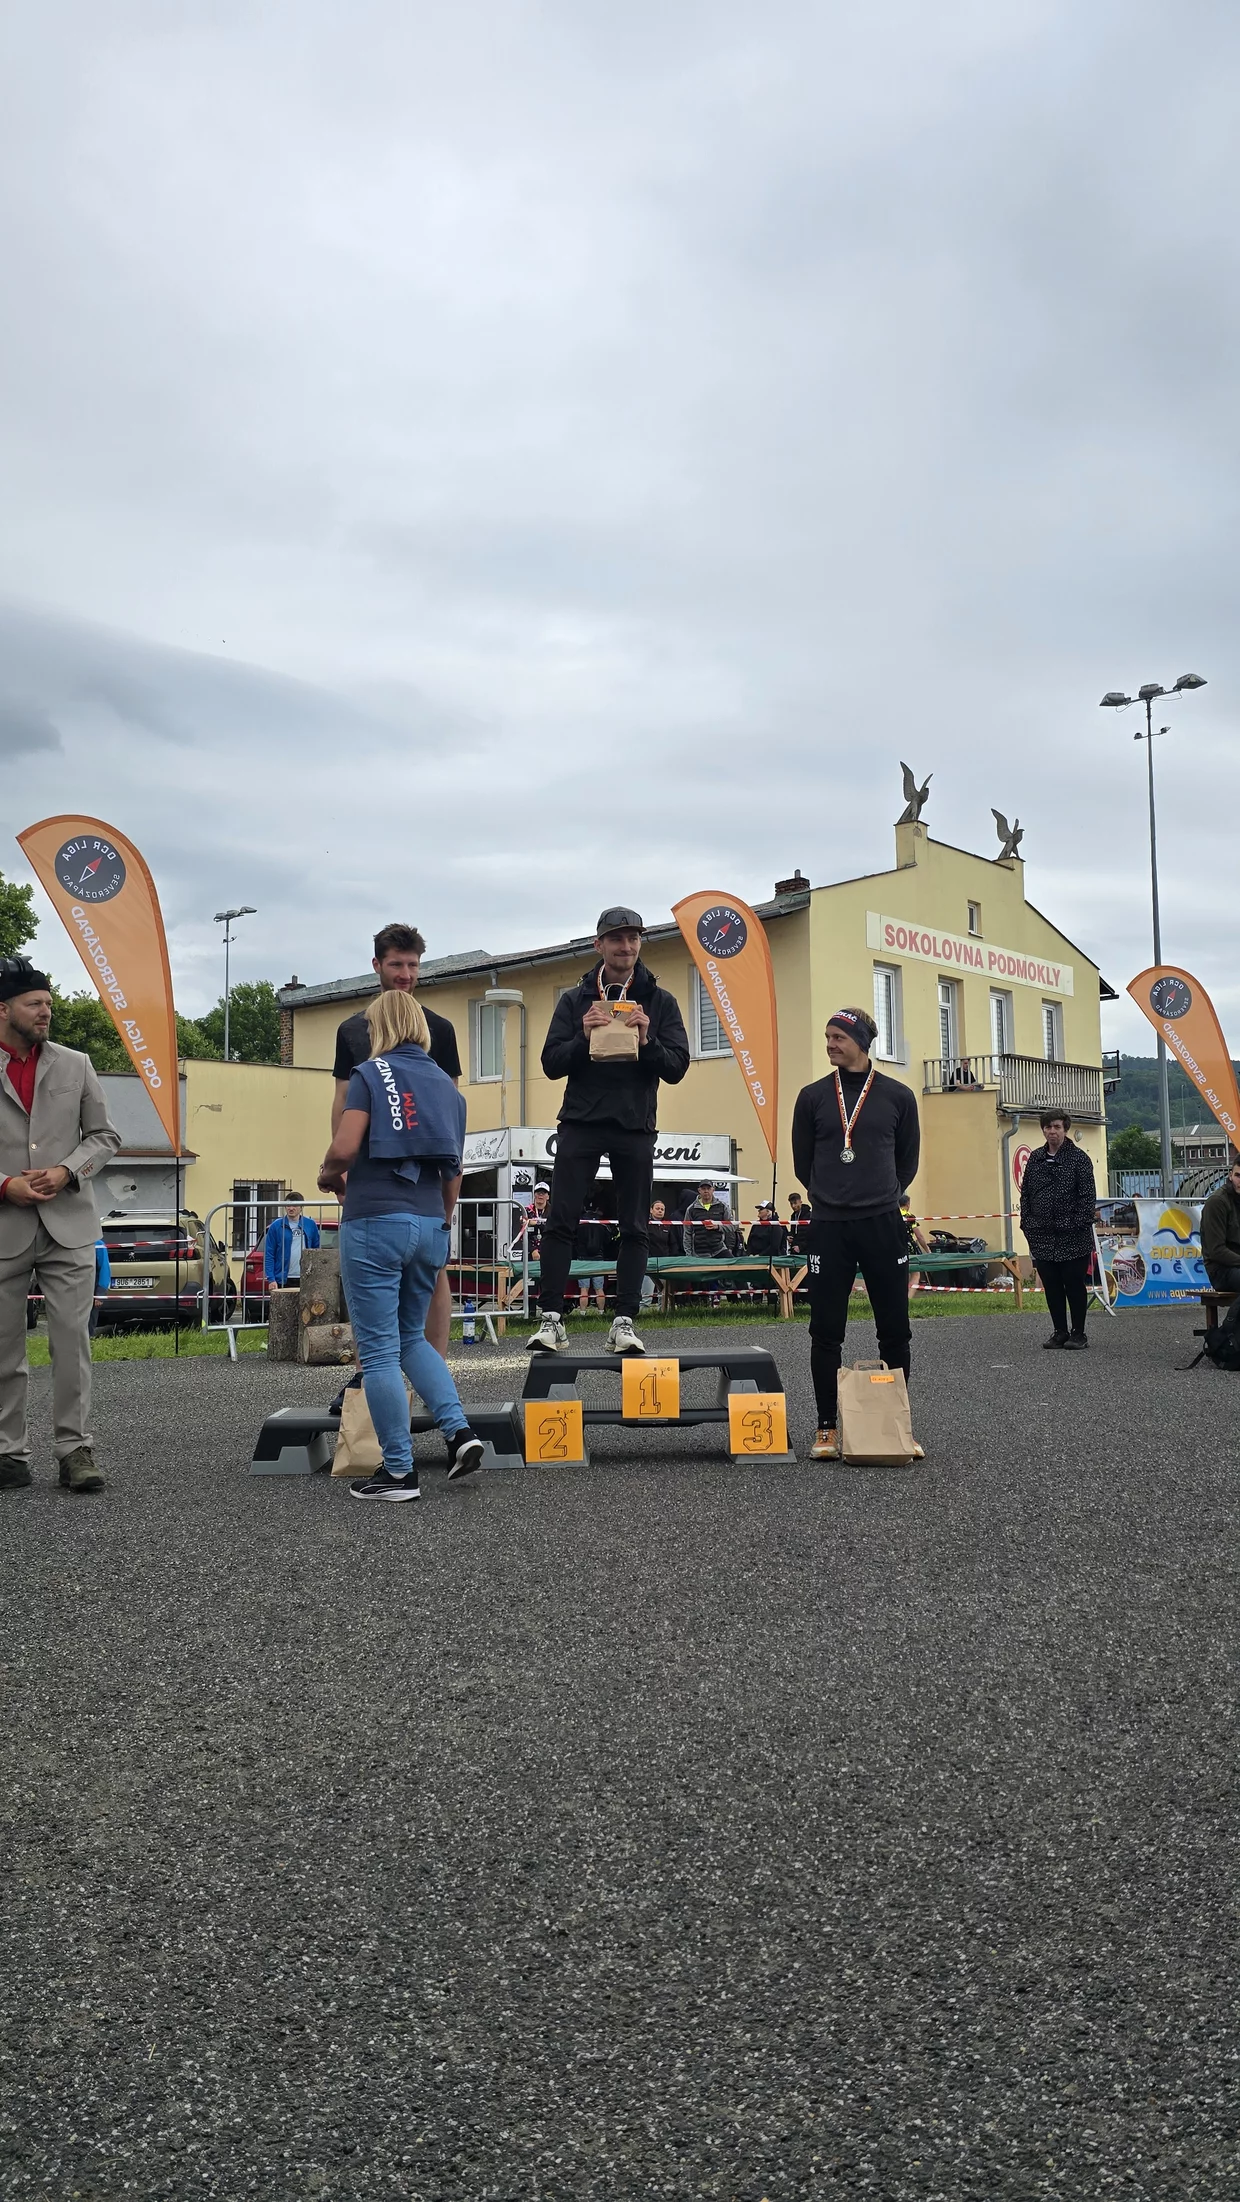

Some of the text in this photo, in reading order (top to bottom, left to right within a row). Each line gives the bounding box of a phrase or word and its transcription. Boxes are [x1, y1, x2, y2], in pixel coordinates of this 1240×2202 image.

[884, 923, 1061, 988] SOKOLOVNA PODMOKLY
[402, 1092, 419, 1130] TÝM
[809, 1254, 821, 1265] VK
[810, 1264, 820, 1274] 33
[639, 1373, 661, 1415] 1
[538, 1417, 568, 1459] 2
[742, 1410, 774, 1451] 3
